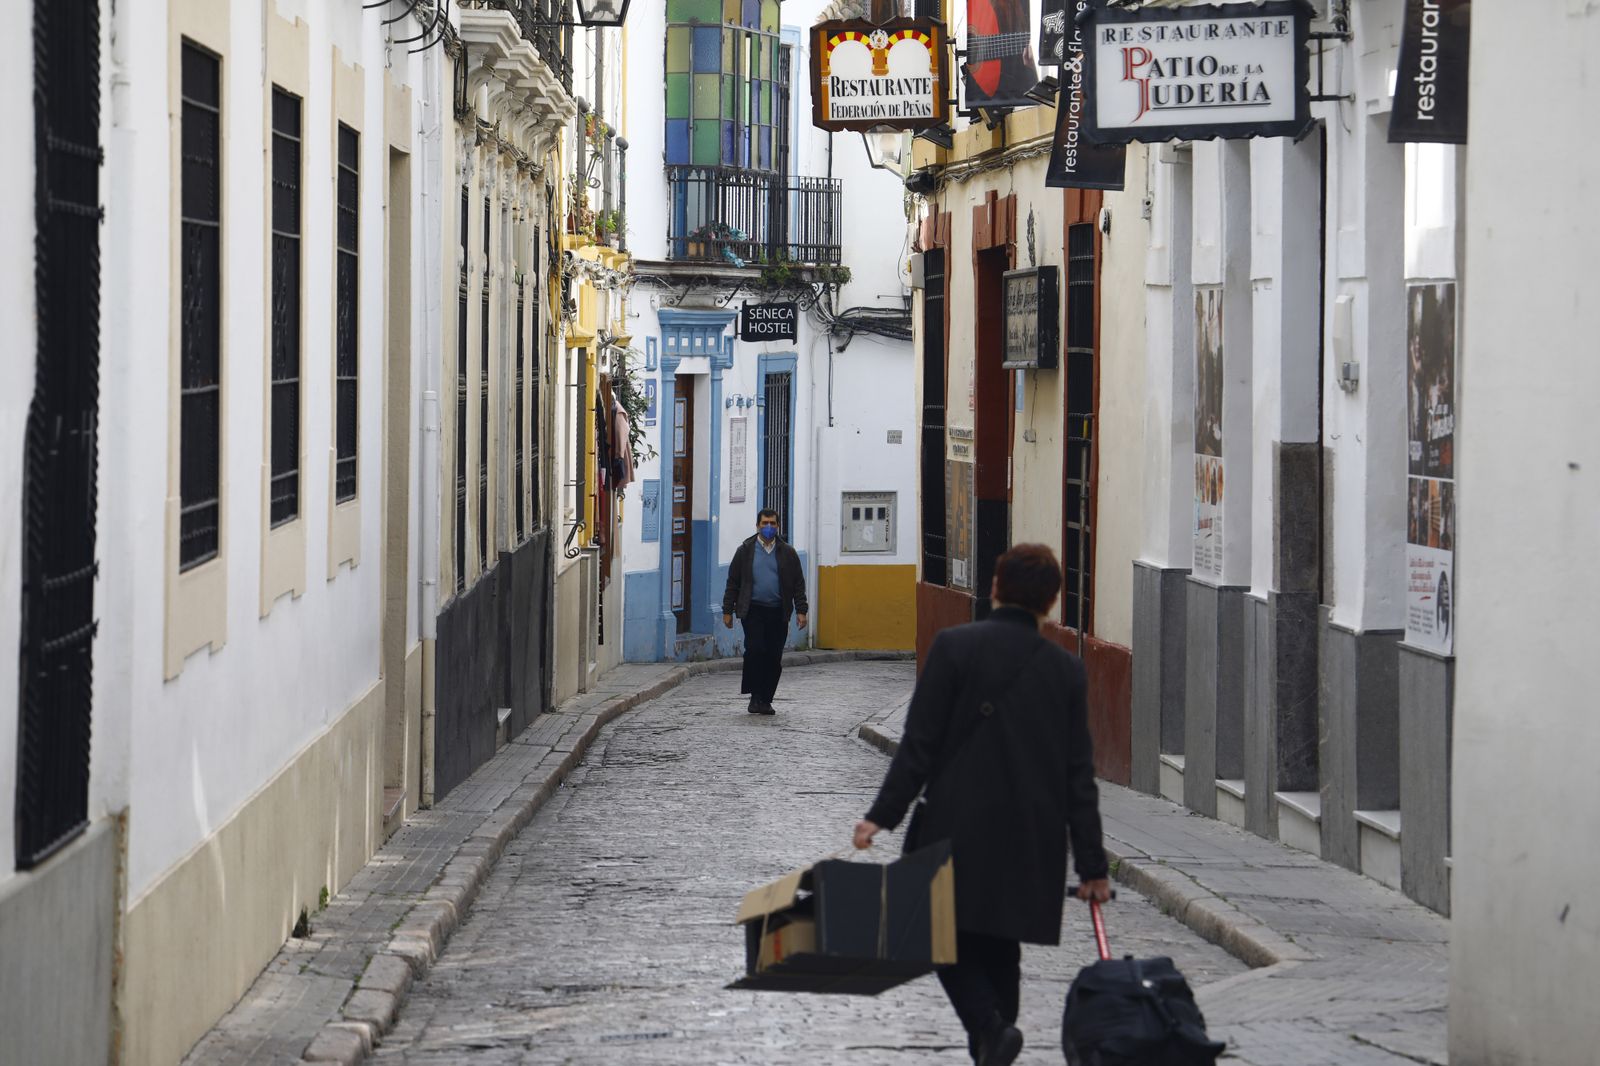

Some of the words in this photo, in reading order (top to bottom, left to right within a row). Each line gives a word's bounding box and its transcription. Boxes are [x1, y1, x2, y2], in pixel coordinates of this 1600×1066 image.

[1102, 20, 1290, 44] RESTAURANTE
[1121, 46, 1219, 81] PATIO
[1219, 64, 1239, 76] DE
[1245, 63, 1264, 75] LA
[830, 75, 932, 98] RESTAURANTE
[831, 100, 886, 119] FEDERACIÓN
[888, 103, 901, 118] DE
[903, 100, 932, 118] PEÑAS
[1129, 77, 1271, 124] JUDERÍA
[749, 306, 794, 320] SÉNECA
[749, 322, 794, 334] HOSTEL
